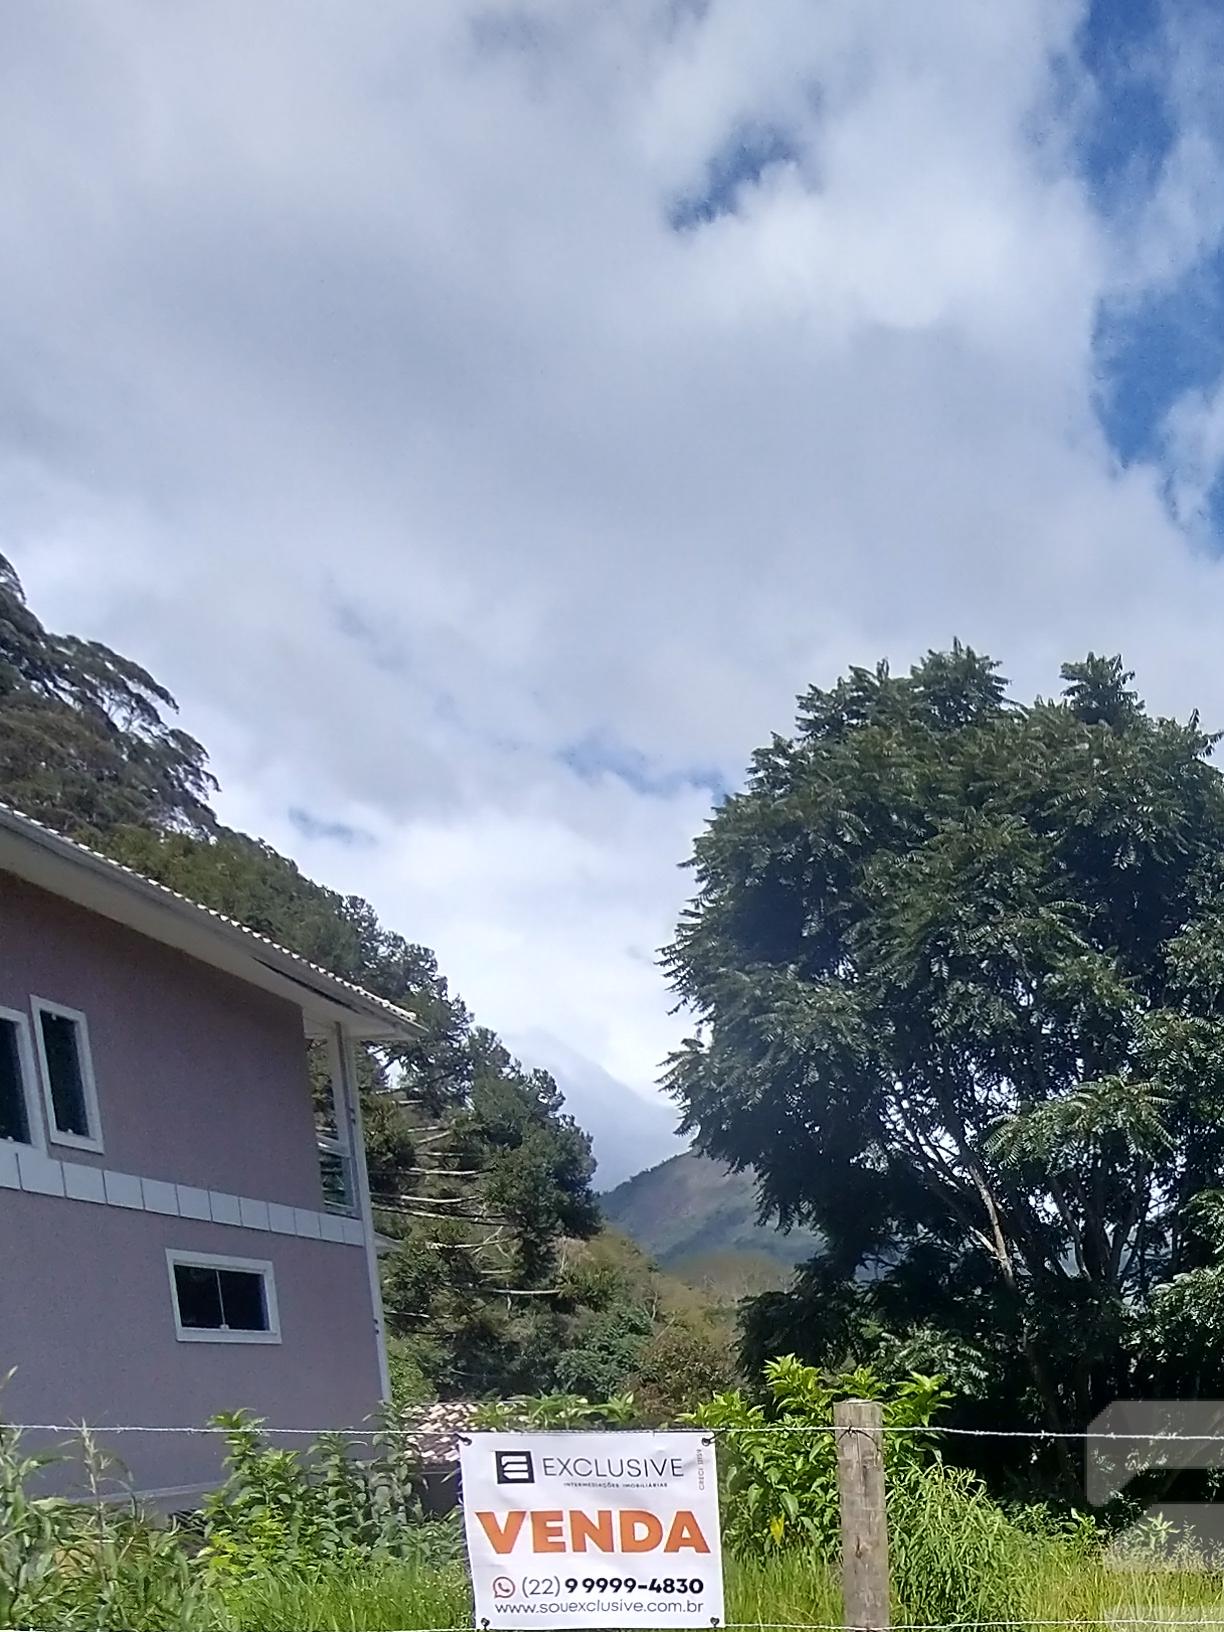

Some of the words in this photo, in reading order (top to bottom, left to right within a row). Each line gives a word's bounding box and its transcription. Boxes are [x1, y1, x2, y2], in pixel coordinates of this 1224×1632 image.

[542, 1457, 685, 1478] EXCLUSIVE
[475, 1510, 712, 1554] VENDA
[521, 1575, 561, 1598] (22)
[494, 1599, 705, 1614] www.souexclusive.com.br
